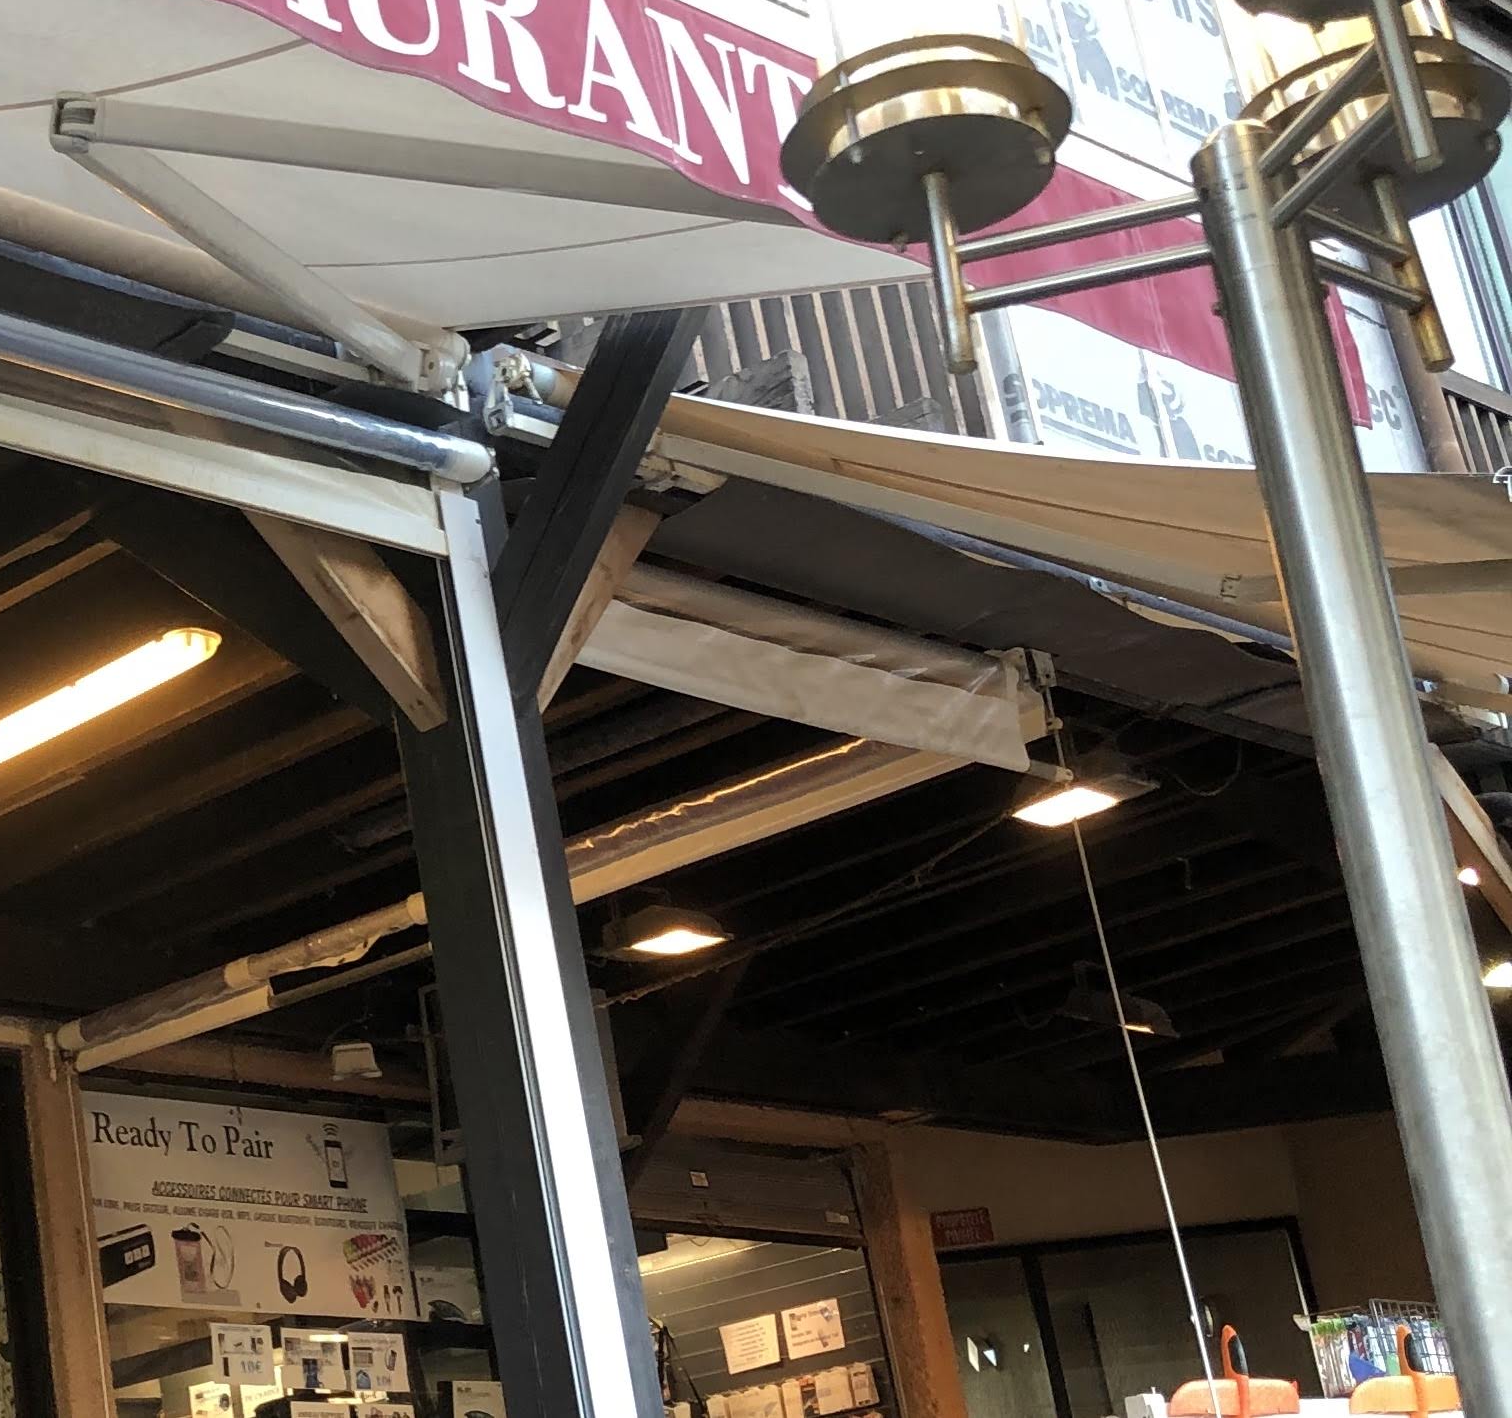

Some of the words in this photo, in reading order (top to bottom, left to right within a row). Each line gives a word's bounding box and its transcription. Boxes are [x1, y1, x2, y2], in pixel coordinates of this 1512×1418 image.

[1116, 67, 1219, 134] SOREMA
[92, 1111, 172, 1156] Ready
[178, 1120, 217, 1154] To
[224, 1125, 275, 1159] Pair
[275, 1190, 300, 1206] POUR
[303, 1193, 334, 1209] SMART
[336, 1196, 368, 1212] PHONE
